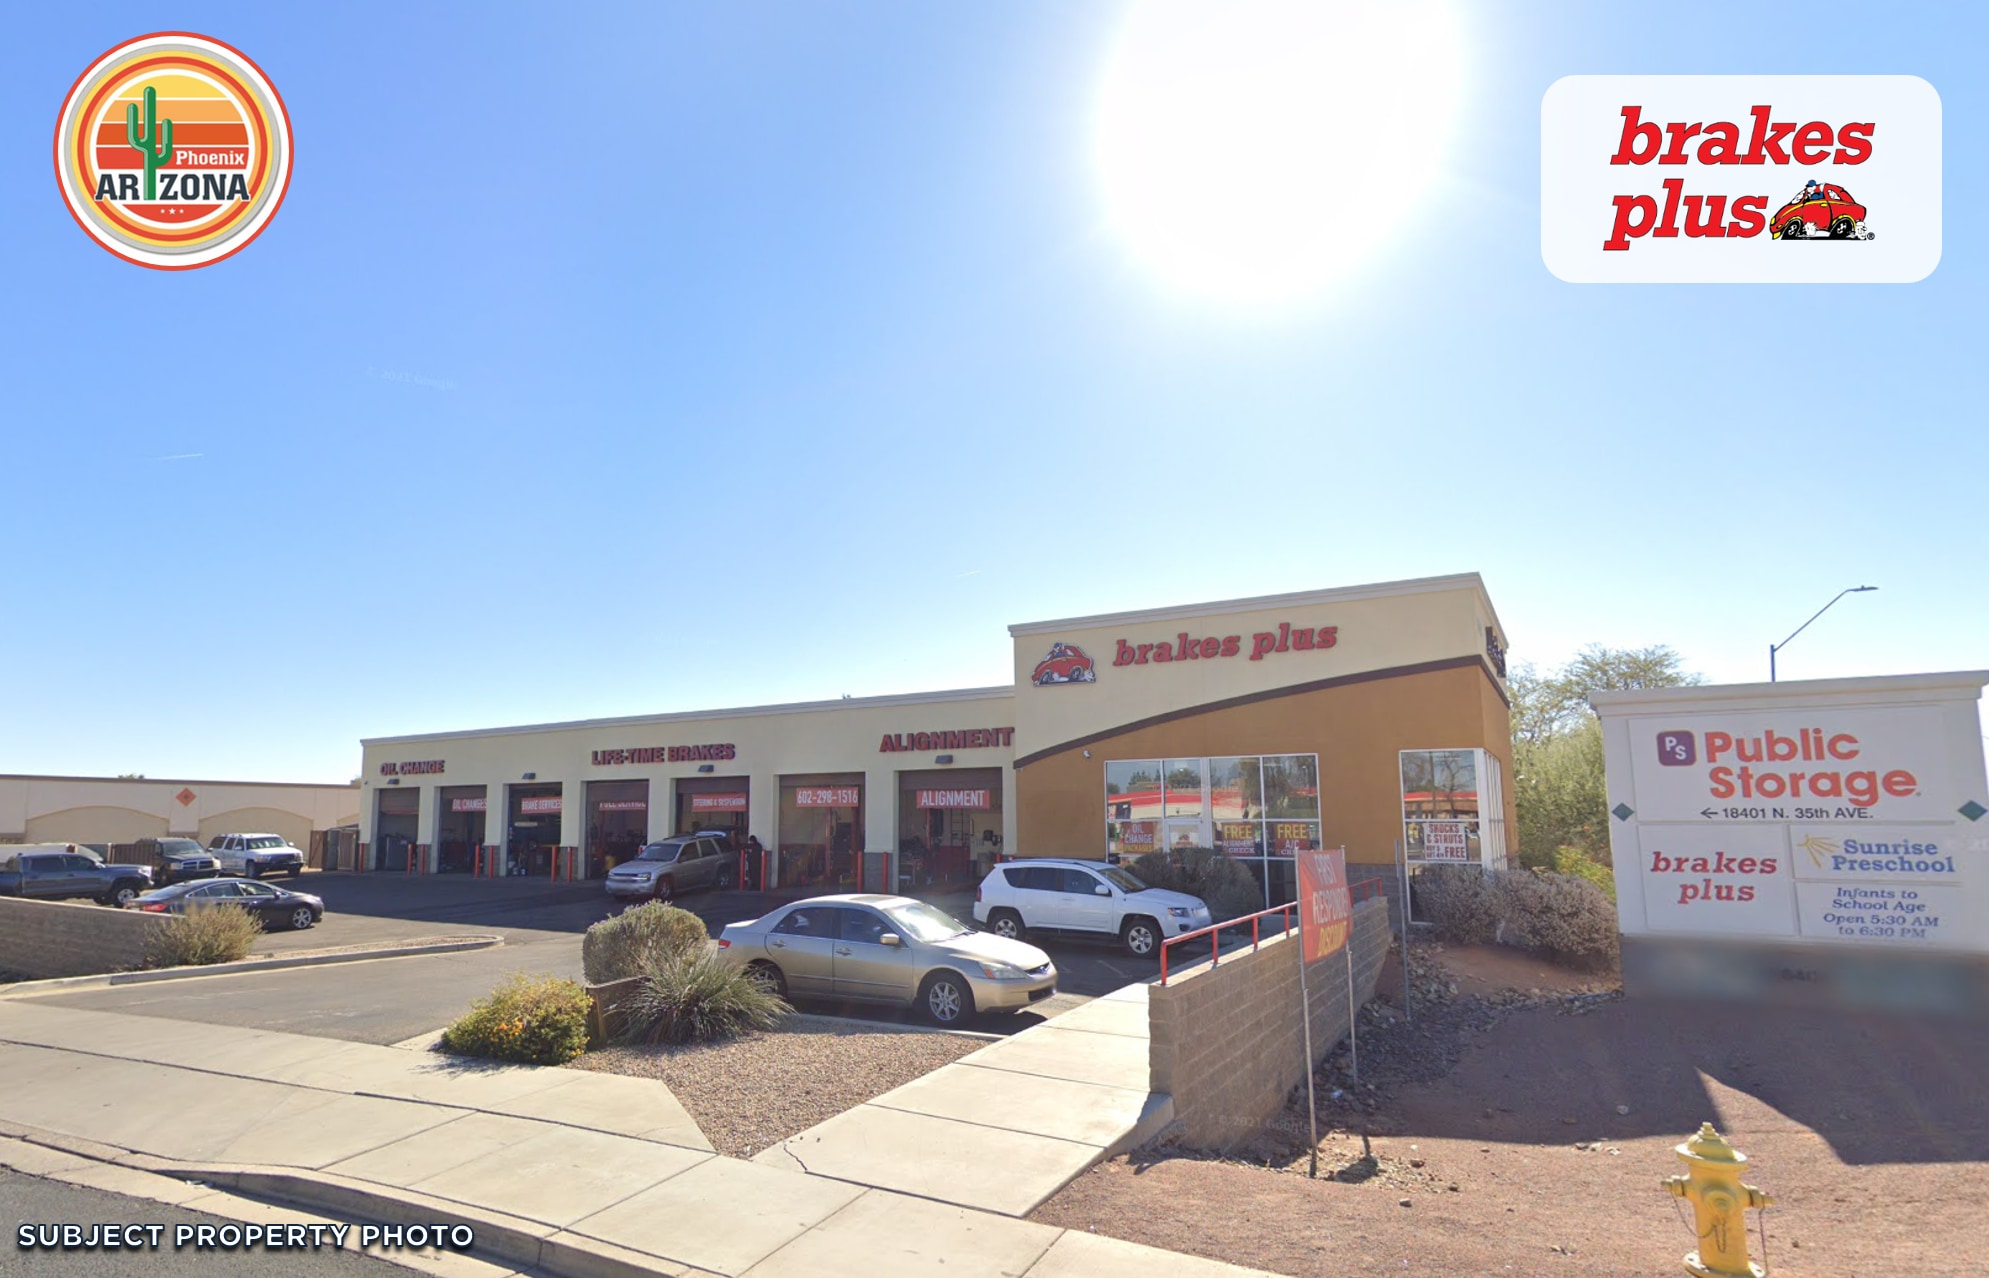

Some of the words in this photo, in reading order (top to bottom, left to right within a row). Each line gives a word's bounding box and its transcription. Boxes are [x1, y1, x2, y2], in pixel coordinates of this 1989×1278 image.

[1113, 632, 1241, 667] brakes
[1249, 622, 1339, 661] plus
[880, 727, 1015, 752] ALIGNMENT
[1704, 727, 1860, 763] Public
[592, 748, 665, 765] LIFE-TIME
[667, 743, 736, 762] BRAKES
[380, 762, 399, 775] OIL
[400, 760, 445, 774] CHANGE
[1709, 766, 1919, 807] Storage
[797, 790, 858, 804] 602-298-1516
[921, 791, 985, 806] ALIGNMENT
[1722, 807, 1766, 818] 18401
[1772, 807, 1790, 818] N.
[1795, 807, 1829, 818] 35th
[1834, 807, 1873, 819] AVE.
[1132, 823, 1144, 834] OIL
[1224, 825, 1252, 840] FREE
[1276, 824, 1307, 839] FREE
[1429, 824, 1459, 833] SHOCKS
[1125, 834, 1152, 844] CHANGE
[1222, 840, 1255, 848] ALIGNMENT
[1285, 840, 1299, 849] A/C
[1434, 834, 1463, 844] STRUTS
[1445, 847, 1465, 858] FREE
[1843, 839, 1938, 856] Sunrise
[1650, 852, 1778, 874] brakes
[1831, 855, 1955, 873] Preschool
[1677, 880, 1755, 904] plus
[1837, 887, 1896, 899] Infants
[1901, 888, 1918, 899] to
[1832, 899, 1889, 911] School
[1893, 901, 1926, 913] Age
[1823, 913, 1865, 926] Open
[1869, 914, 1907, 926] 5:30
[1911, 916, 1939, 927] AM
[1838, 925, 1855, 937] to
[1858, 925, 1896, 938] 6:30
[1900, 928, 1926, 939] PM
